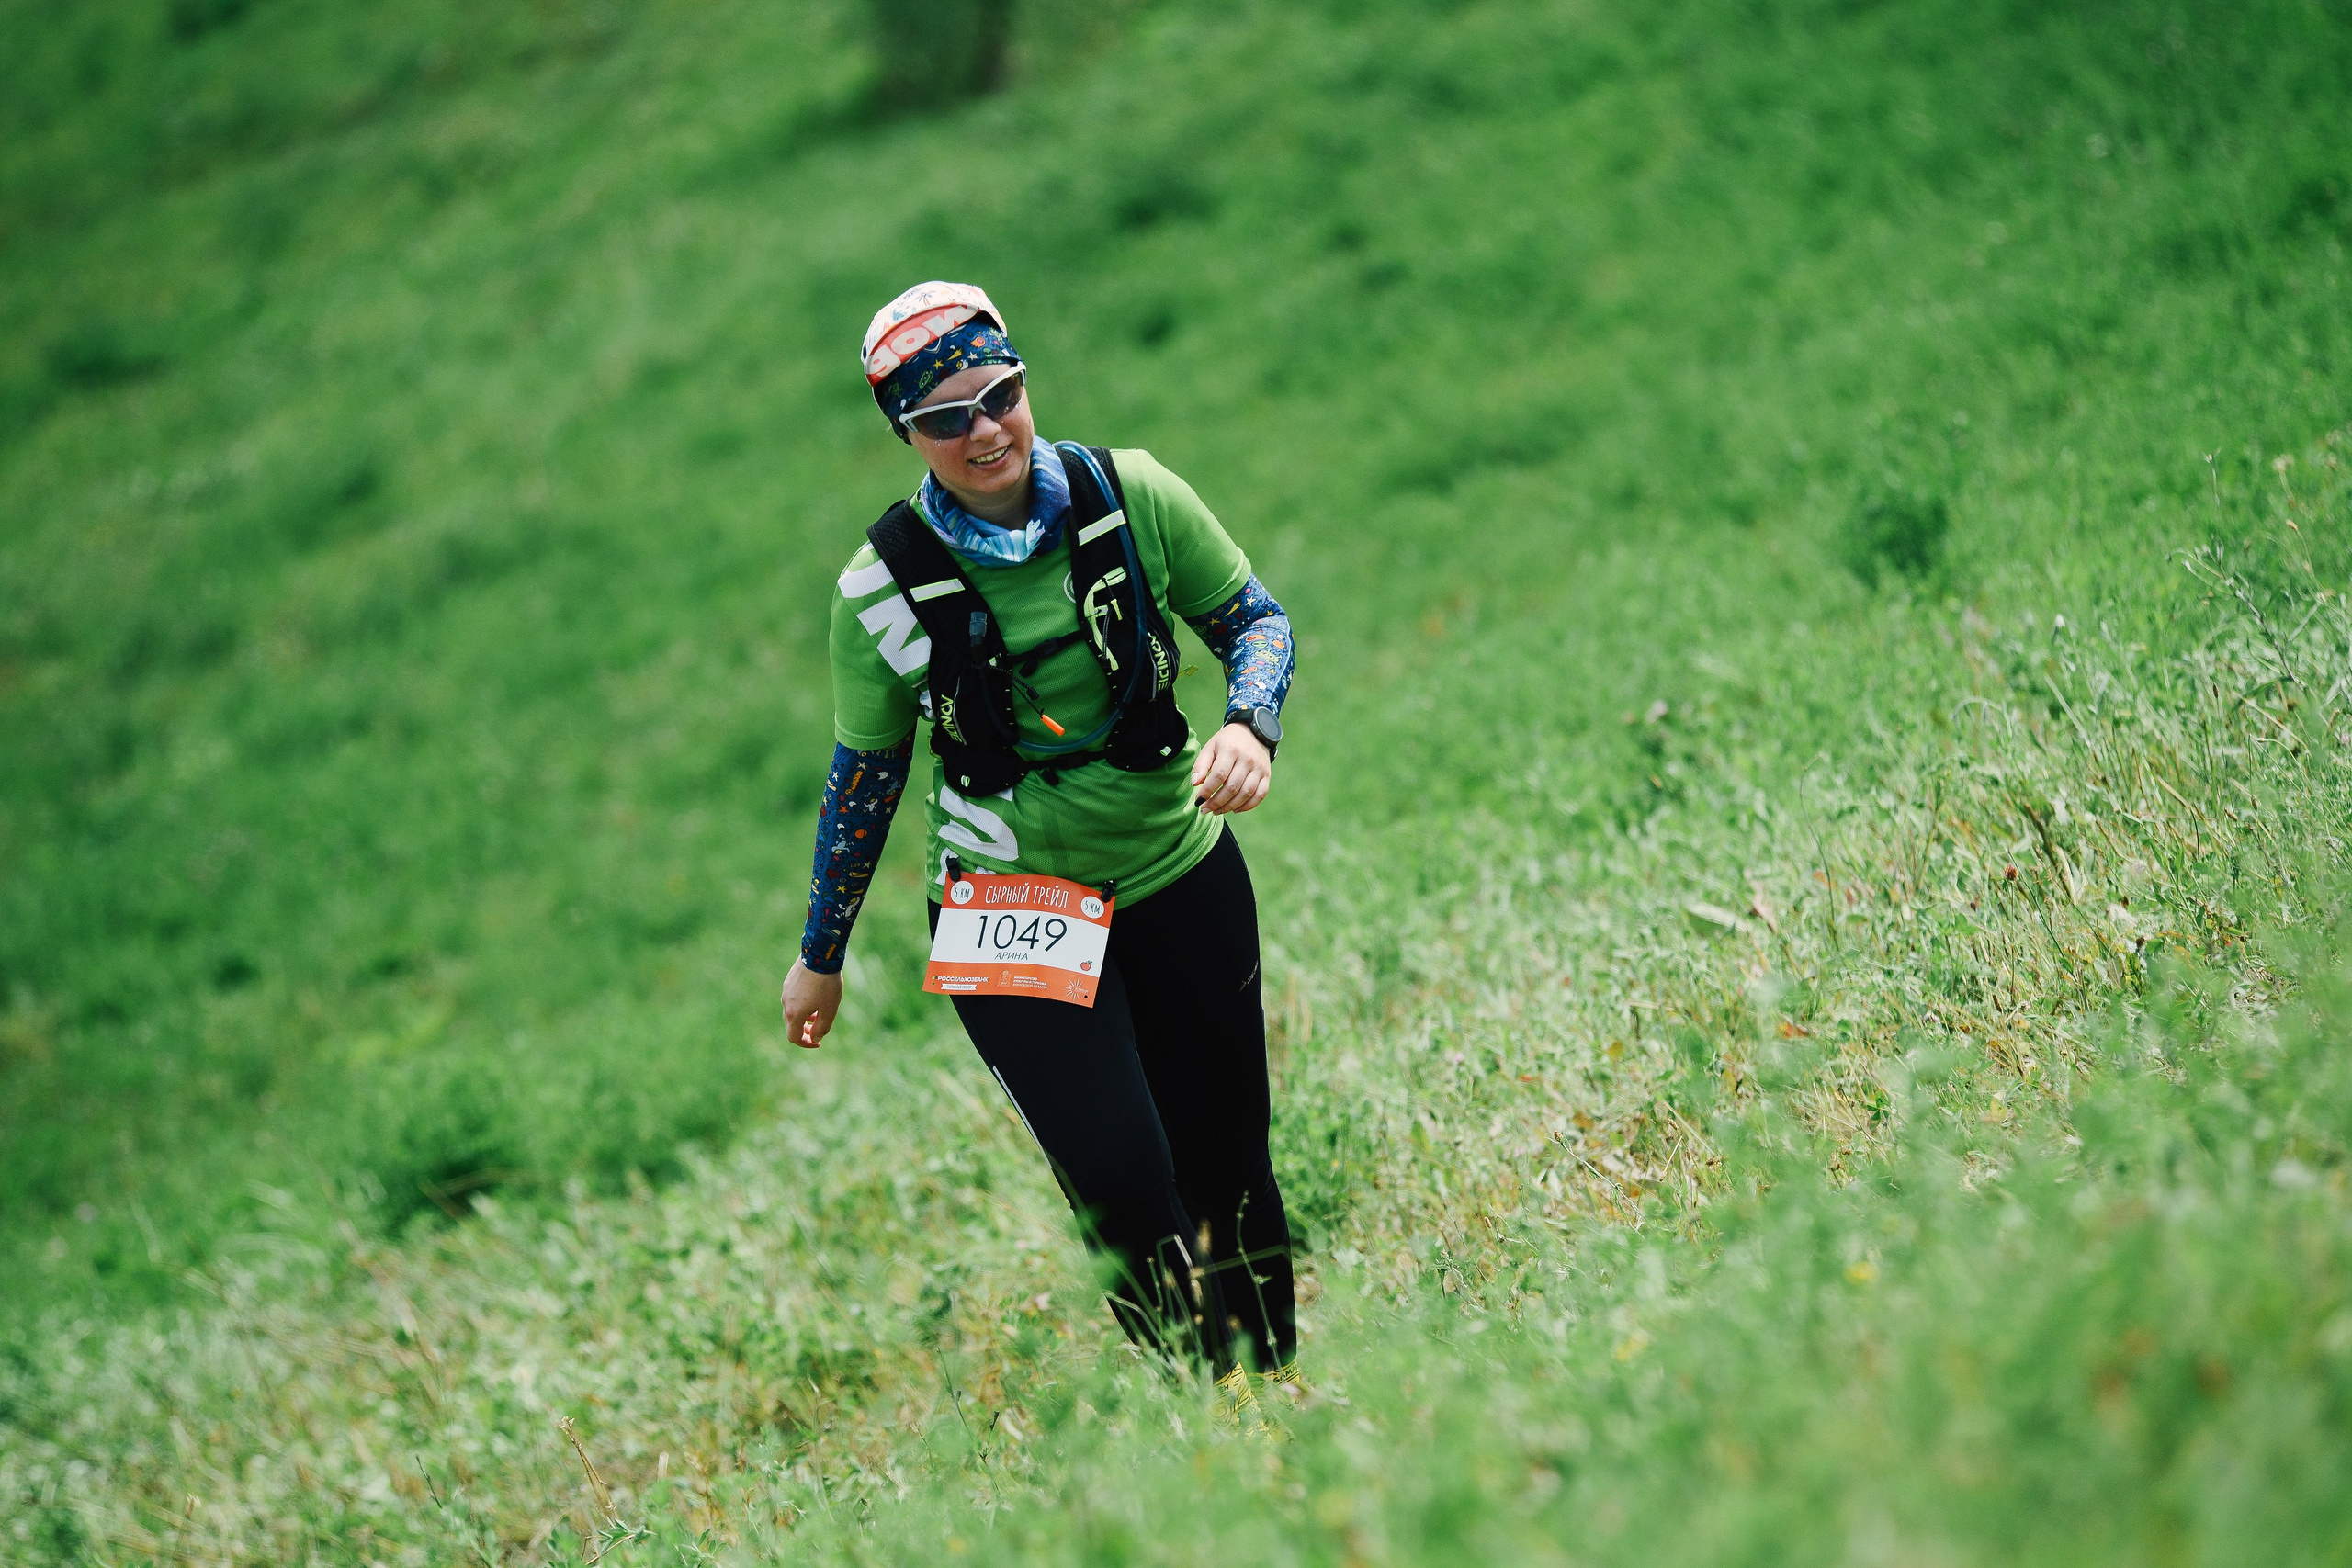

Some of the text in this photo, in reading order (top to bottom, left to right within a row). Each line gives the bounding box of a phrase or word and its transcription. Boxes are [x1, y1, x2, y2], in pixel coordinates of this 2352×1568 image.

[985, 882, 1069, 909] СЫРНЫЙ ТРЕЙЛ
[977, 914, 1068, 953] 1049
[994, 951, 1029, 961] АРИНА
